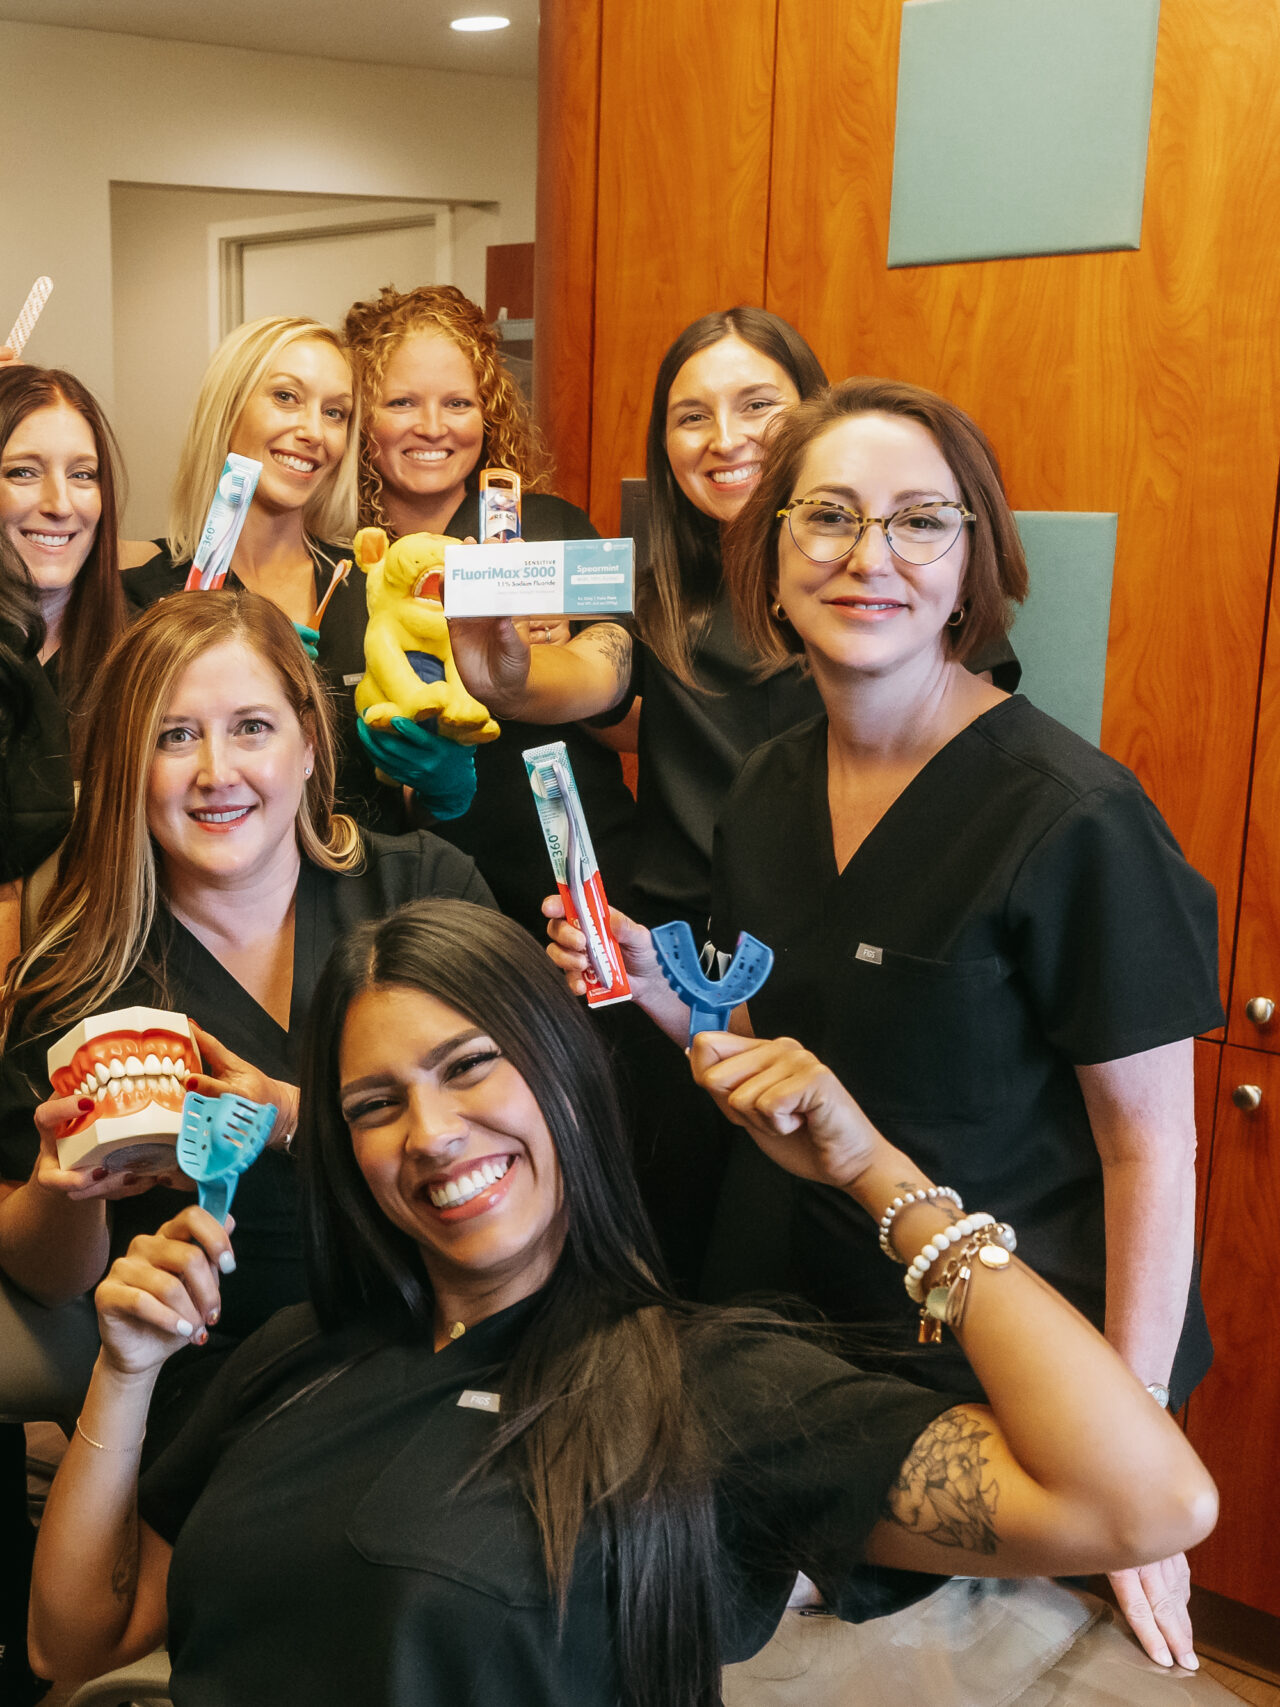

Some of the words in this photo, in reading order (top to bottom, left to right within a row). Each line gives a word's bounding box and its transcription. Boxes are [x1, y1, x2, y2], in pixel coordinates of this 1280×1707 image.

[452, 567, 520, 581] FluoriMax
[523, 566, 556, 579] 5000
[576, 564, 620, 574] Spearmint
[863, 949, 875, 958] FIGS
[470, 1395, 490, 1406] FIGS
